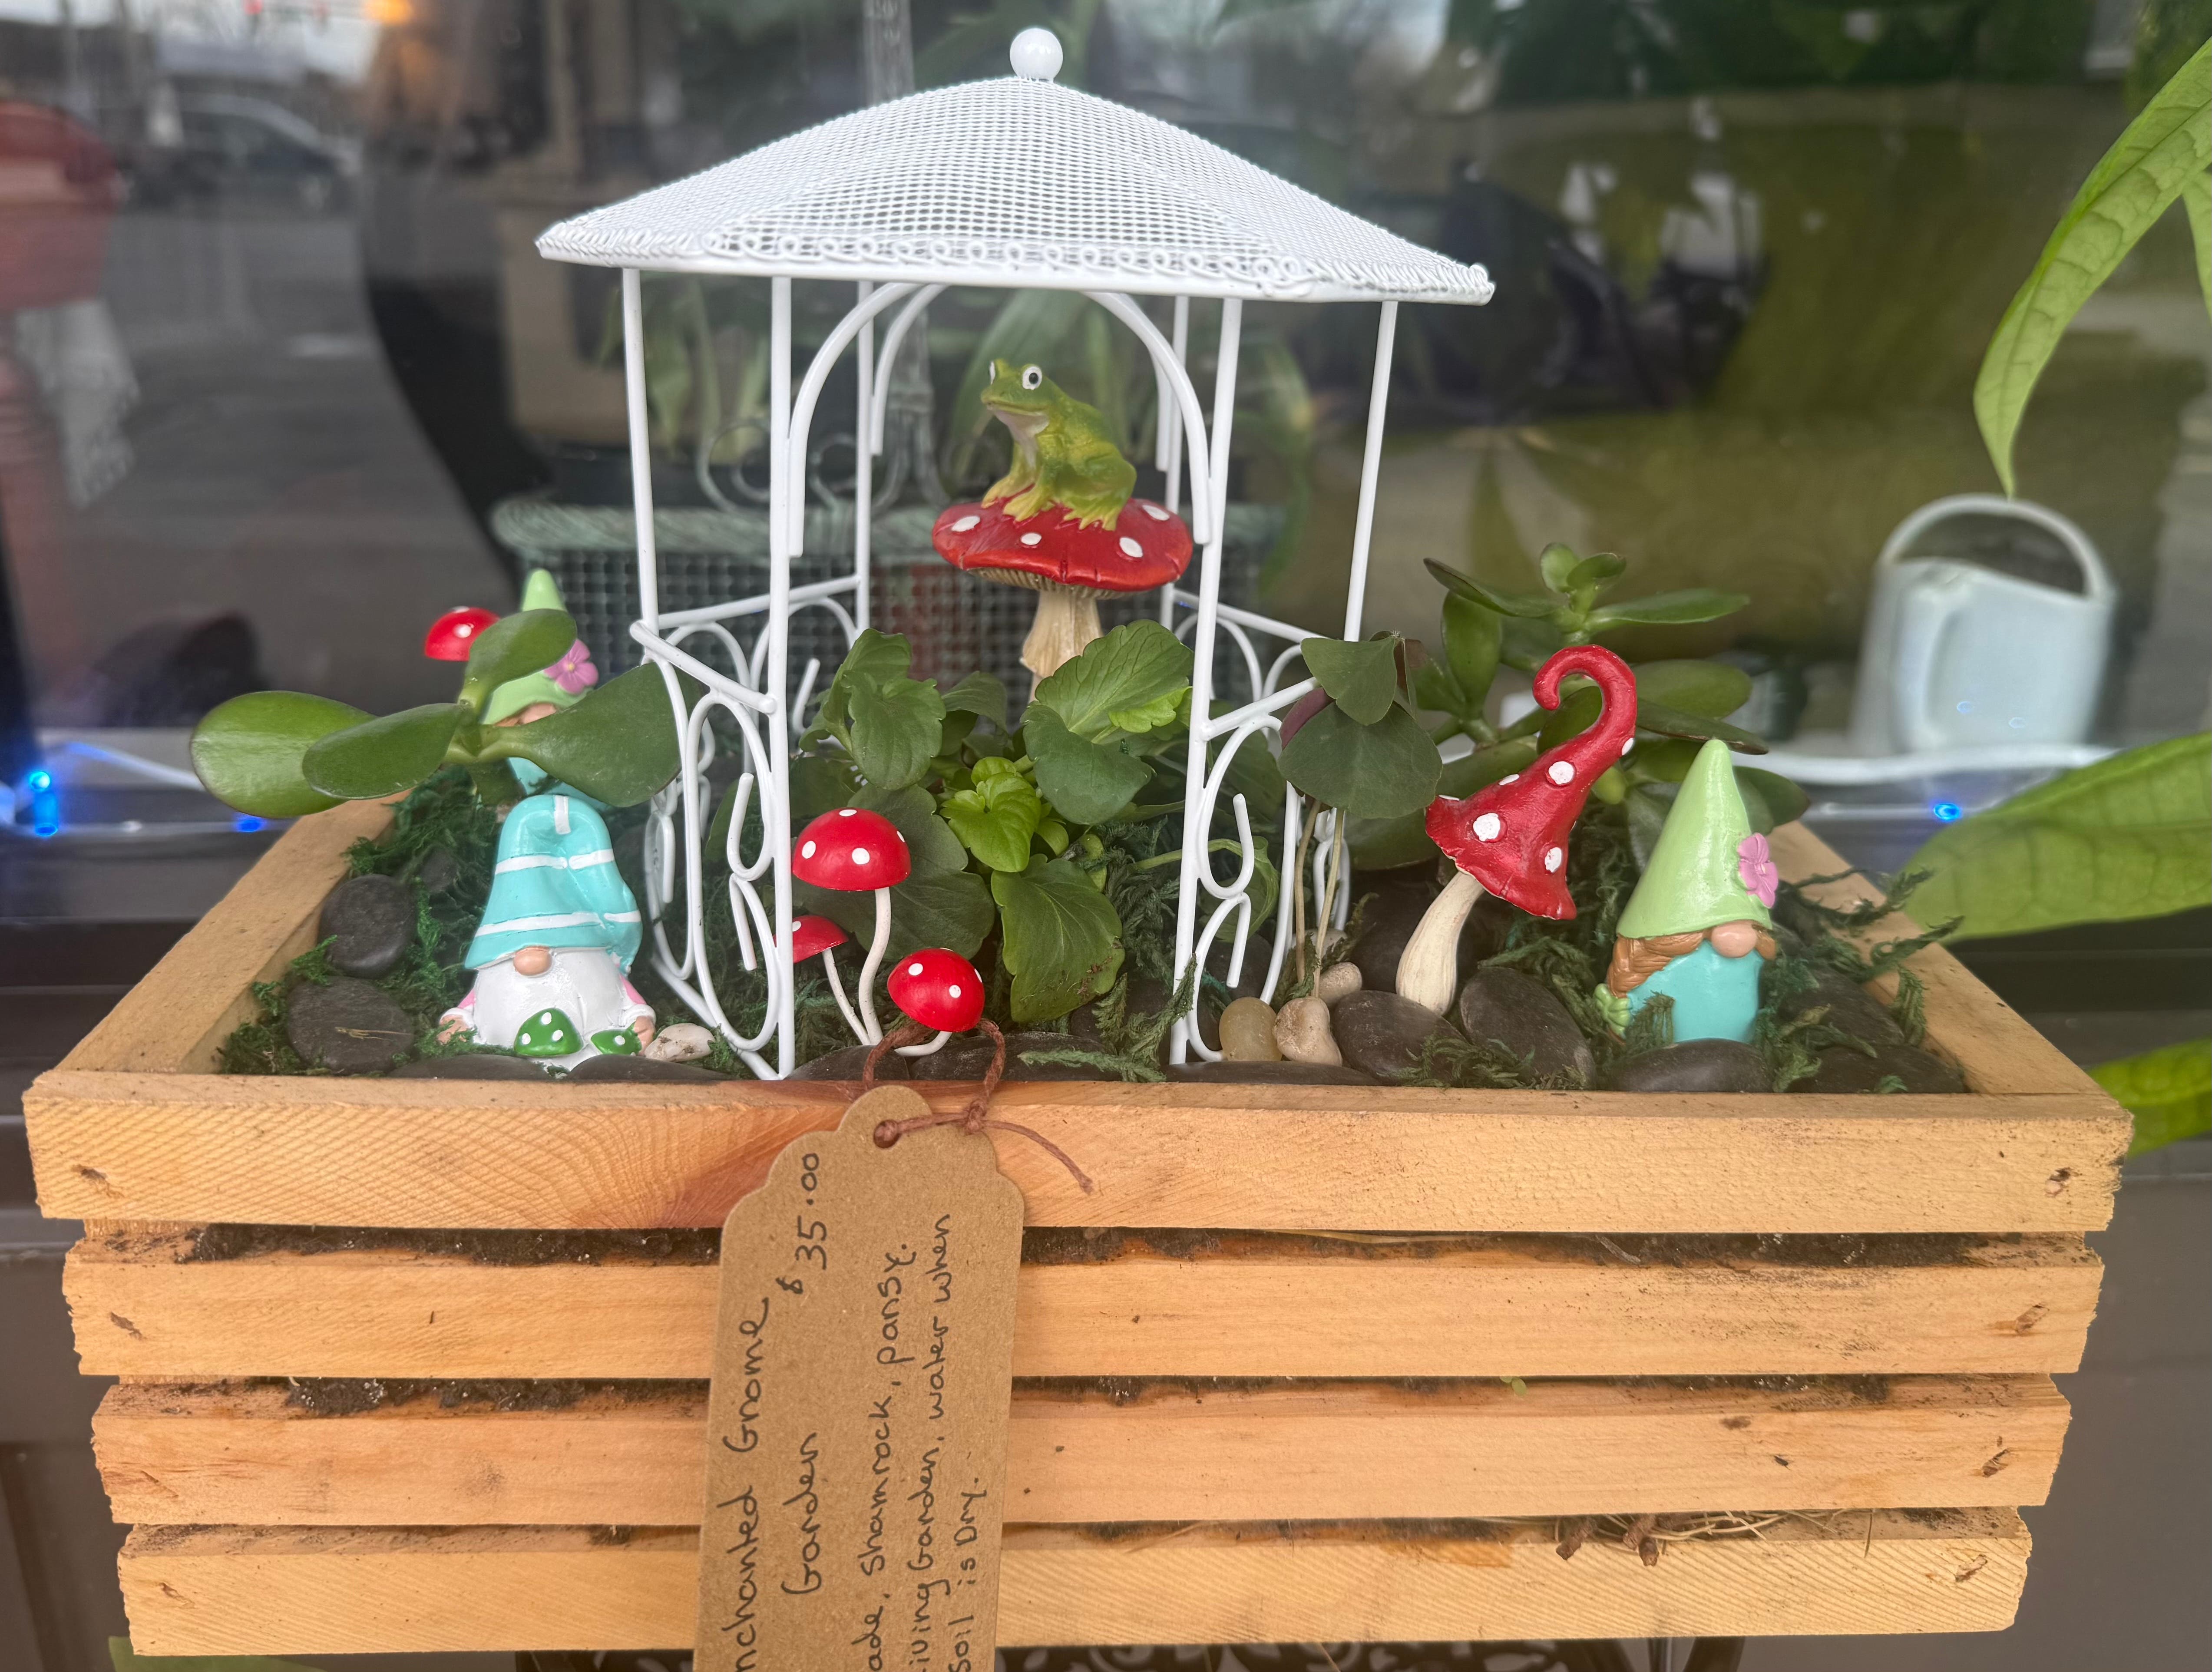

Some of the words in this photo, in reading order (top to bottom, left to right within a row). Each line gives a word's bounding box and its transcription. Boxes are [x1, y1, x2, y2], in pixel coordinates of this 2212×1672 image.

[925, 1213, 952, 1303] when
[722, 1296, 770, 1453] Gnome
[922, 1315, 949, 1420] water
[850, 1593, 891, 1672] ade,
[876, 1243, 917, 1365] pansy.
[780, 1432, 822, 1595] Garden
[953, 1477, 988, 1547] Dry.
[716, 1484, 759, 1672] nchanted
[957, 1557, 976, 1586] is
[909, 1578, 951, 1672] iving
